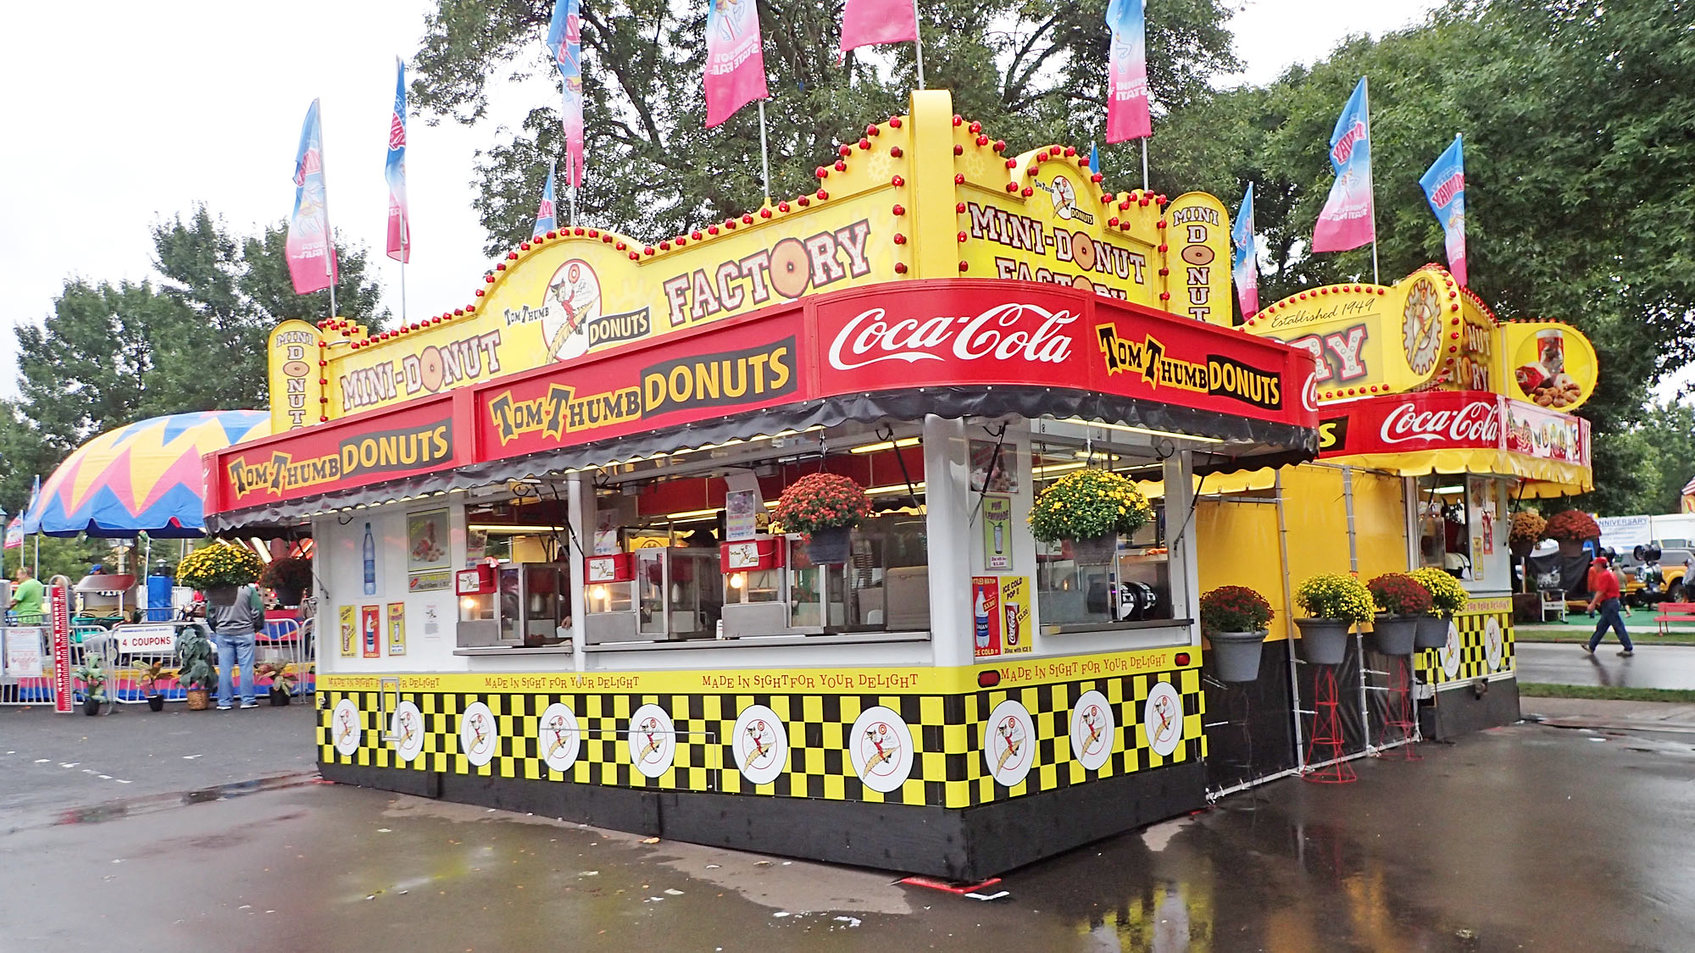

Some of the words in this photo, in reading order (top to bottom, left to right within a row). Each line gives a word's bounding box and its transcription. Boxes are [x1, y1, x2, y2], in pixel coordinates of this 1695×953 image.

[1173, 206, 1219, 226] MINI
[968, 201, 1145, 284] MINI-DONUT
[663, 218, 871, 327] FACTORY
[504, 308, 521, 326] TOM
[521, 305, 550, 324] THUMB
[589, 312, 648, 343] DONUTS
[1271, 305, 1338, 328] Established
[1342, 298, 1375, 315] 1949
[276, 331, 314, 347] MINI
[829, 303, 1080, 370] Coca-Cola
[340, 329, 501, 412] MINI-DONUT
[1097, 324, 1142, 373] TOM
[1143, 335, 1208, 389] THUMB
[1209, 361, 1280, 405] DONUTS
[283, 346, 310, 430] DONUT
[491, 392, 543, 443] TOM
[543, 384, 640, 440] THUMB
[643, 347, 791, 412] DONUTS
[1381, 402, 1498, 443] Coca-Cola
[229, 457, 269, 496] TOM
[269, 452, 340, 495] THUMB
[341, 426, 449, 475] DONUTS
[1010, 577, 1023, 589] COLD
[122, 638, 128, 646] 4
[131, 636, 172, 647] COUPONS
[409, 677, 440, 689] DELIGHT
[485, 677, 508, 689] MADE
[510, 678, 520, 688] IN
[521, 677, 547, 689] SIGHT
[549, 677, 568, 689] FOR
[570, 676, 595, 689] YOUR
[597, 676, 640, 689] DELIGHT
[702, 675, 735, 689] MADE
[738, 675, 750, 688] IN
[753, 674, 788, 689] SIGHT
[790, 674, 815, 689] FOR
[820, 673, 854, 689] YOUR
[858, 673, 919, 689] DELIGHT
[1001, 666, 1032, 682] MADE
[1035, 665, 1046, 679] IN
[1049, 661, 1078, 677] SIGHT
[1081, 660, 1101, 675] FOR
[1103, 657, 1128, 671] YOUR
[1130, 654, 1167, 669] DELIGHT
